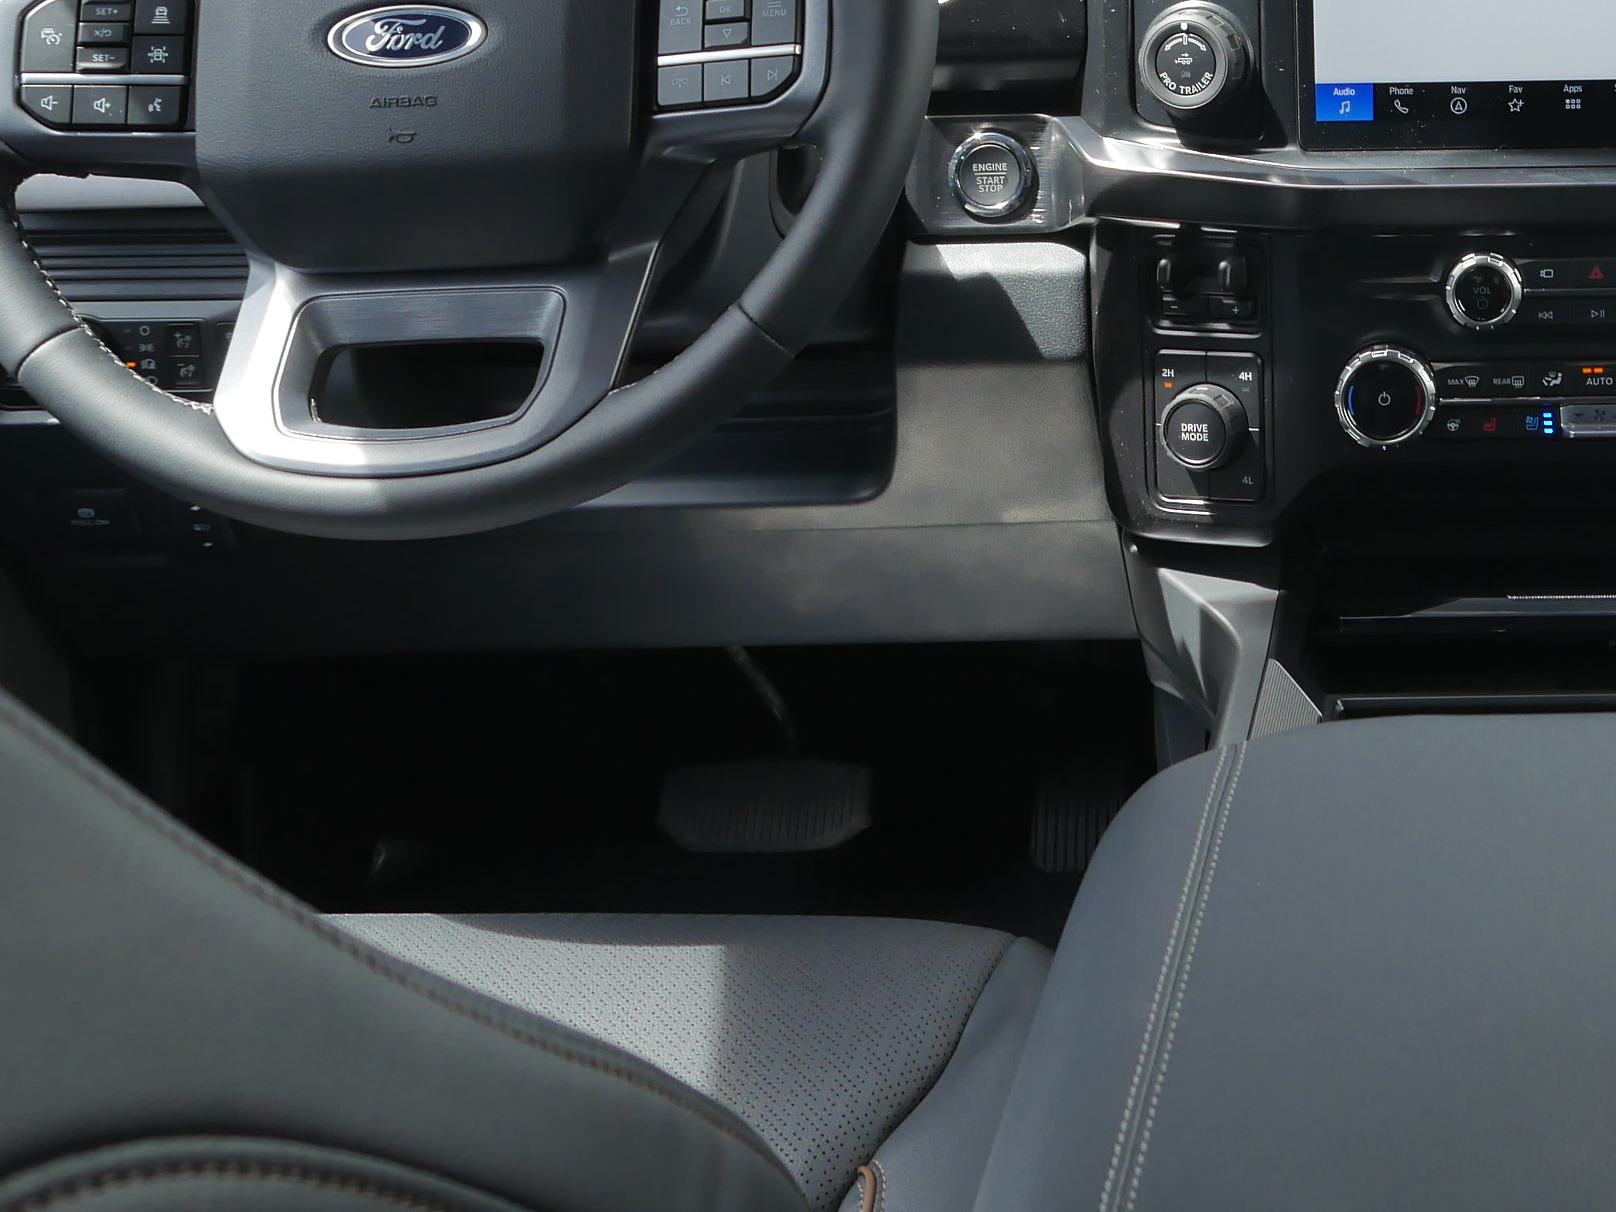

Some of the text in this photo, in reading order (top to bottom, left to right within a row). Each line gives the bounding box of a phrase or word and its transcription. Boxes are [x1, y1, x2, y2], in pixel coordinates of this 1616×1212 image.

[719, 5, 731, 13] OK
[761, 9, 787, 17] MENU
[670, 18, 691, 27] BACK
[365, 18, 446, 52] Ford
[1159, 71, 1214, 95] PRO TRAILER
[1333, 87, 1355, 96] Audio
[1389, 87, 1414, 96] Phone
[1451, 86, 1466, 94] Nav
[1508, 85, 1523, 93] Fav
[1563, 84, 1582, 94] Apps
[369, 96, 438, 108] AIRBAG
[972, 162, 1008, 172] ENGINE
[976, 176, 1006, 185] START
[978, 184, 1003, 193] STOP
[1473, 287, 1491, 295] VOL
[1161, 368, 1174, 377] 2H
[1239, 372, 1253, 381] 4H
[1586, 377, 1613, 386] AUTO
[1181, 423, 1208, 433] DRIVE
[1181, 432, 1209, 442] MODE
[1242, 476, 1254, 485] 4L
